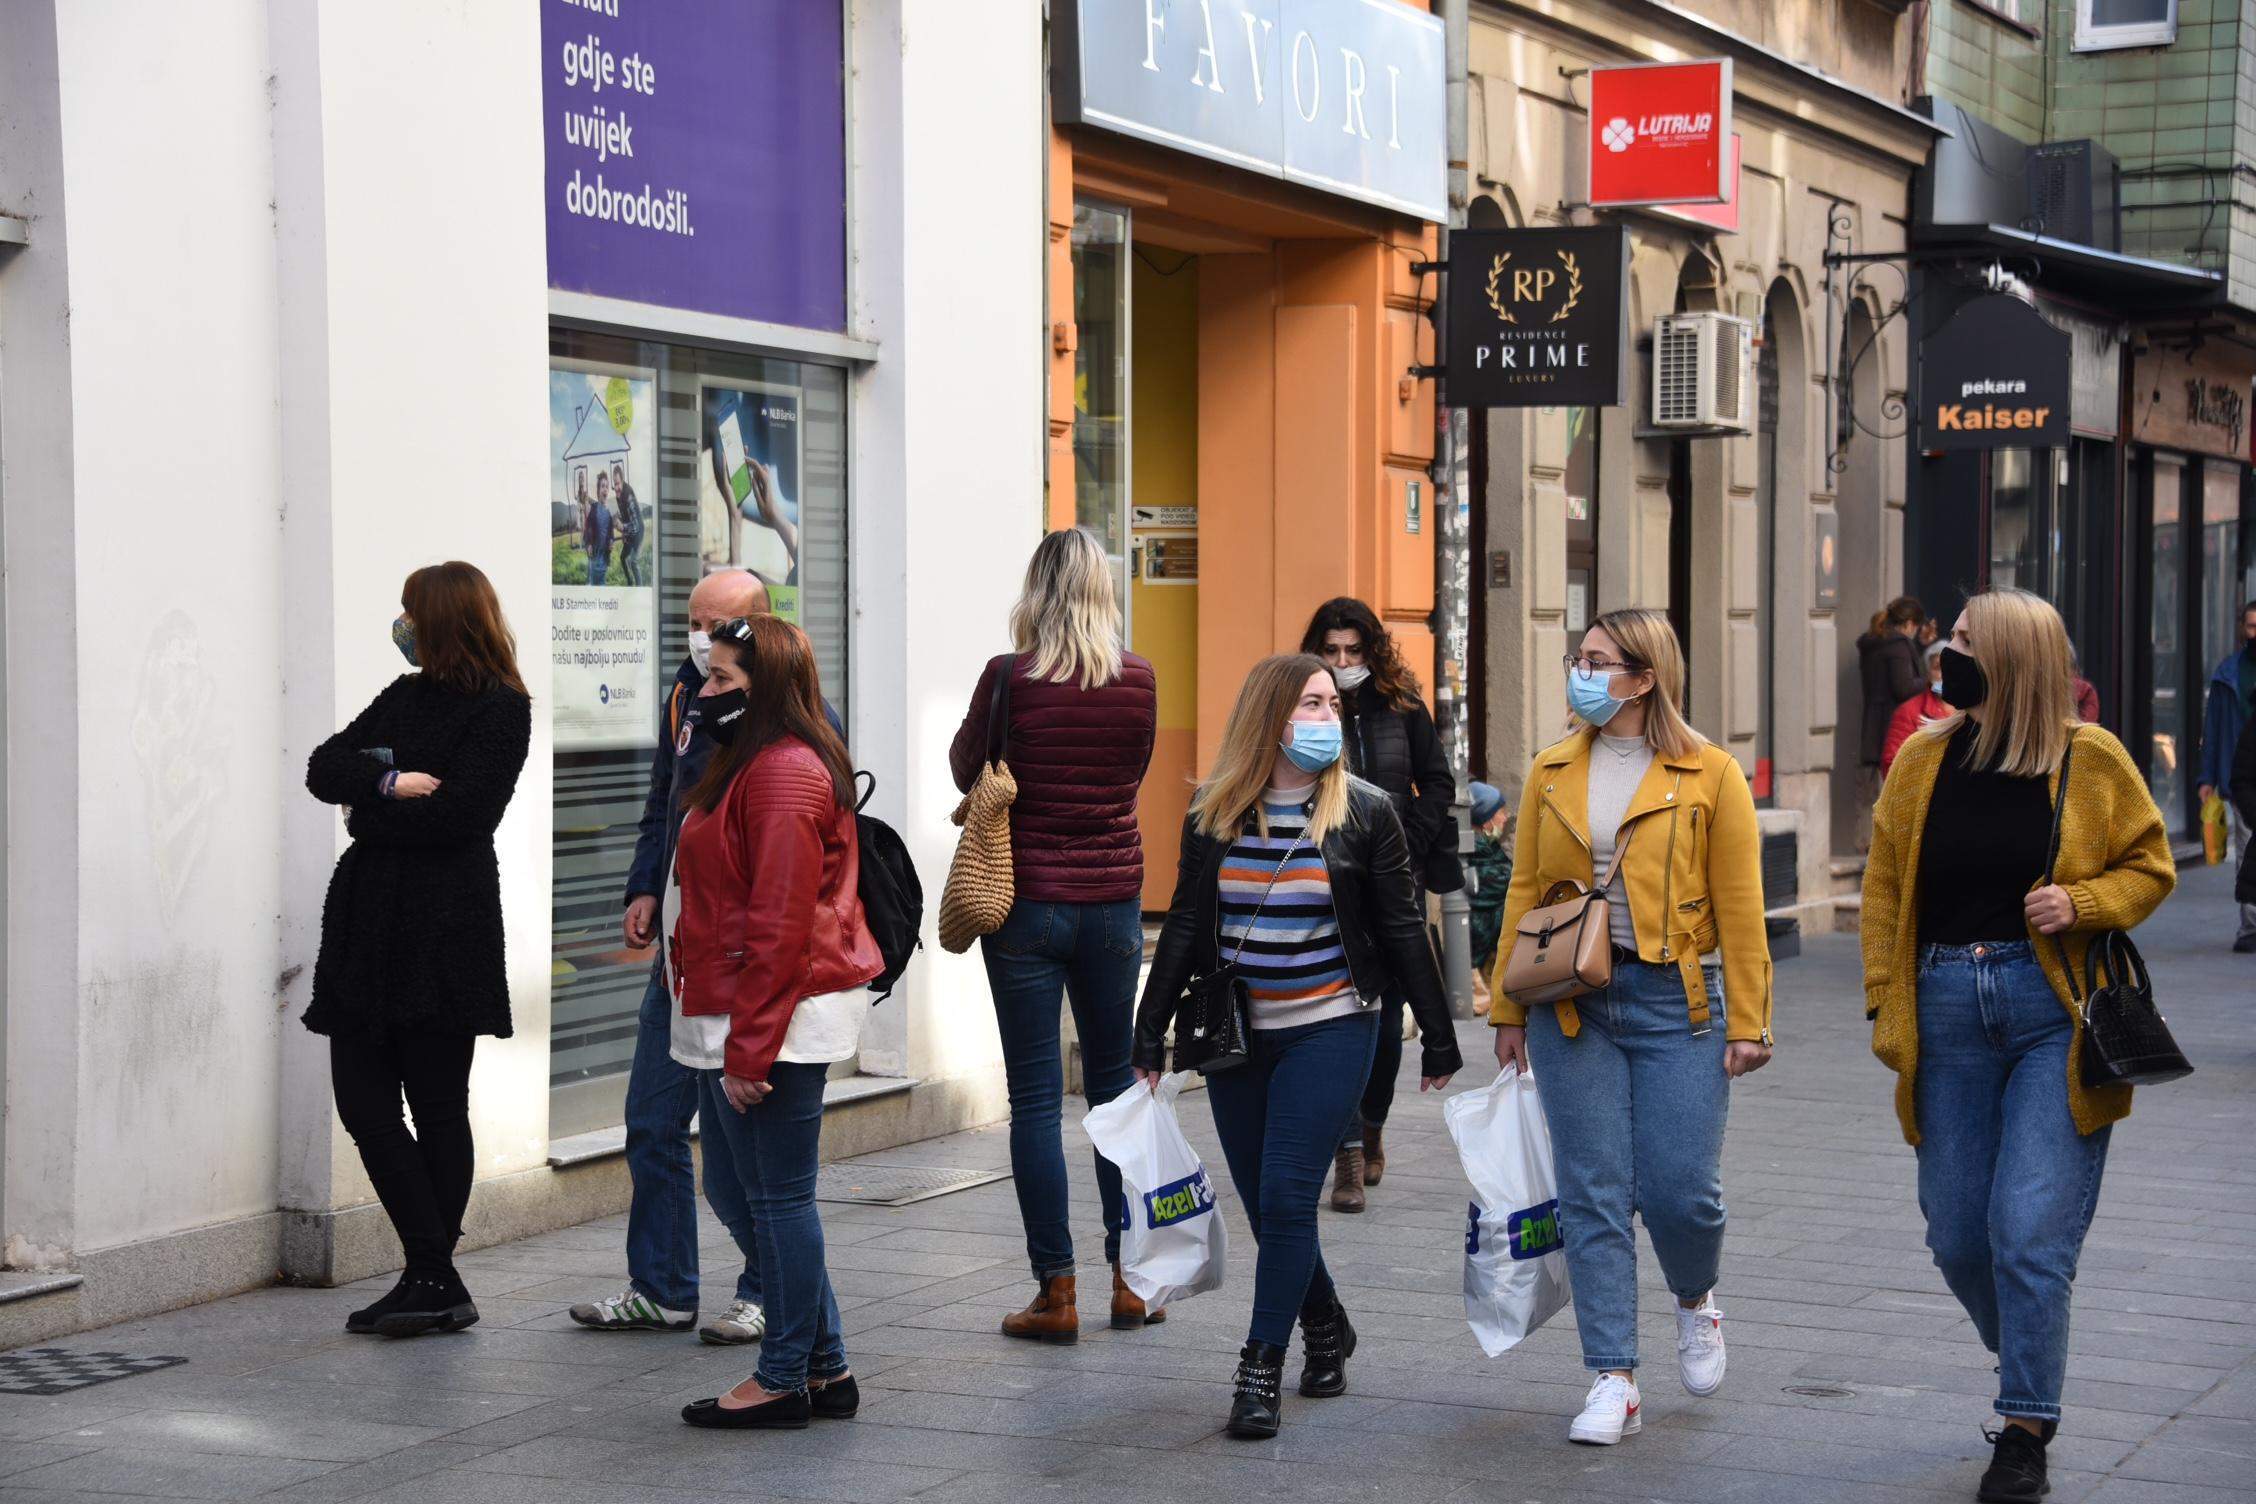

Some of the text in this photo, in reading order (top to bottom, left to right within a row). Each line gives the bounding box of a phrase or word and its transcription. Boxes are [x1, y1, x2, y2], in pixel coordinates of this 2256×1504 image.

[563, 34, 655, 95] gdje ste
[1142, 0, 1401, 150] FAVORI
[565, 106, 633, 162] uvijek
[1638, 113, 1712, 135] LUTRIJA
[567, 169, 694, 236] dobrodošli.
[1513, 269, 1555, 302] RP
[1499, 330, 1566, 340] RESIDENCE
[1476, 344, 1589, 368] PRIME
[1962, 379, 2026, 398] pekara
[1938, 403, 2050, 430] Kaiser
[592, 626, 634, 645] poslovnicu
[636, 629, 647, 644] po
[552, 649, 572, 665] našu
[574, 648, 610, 668] najbolju
